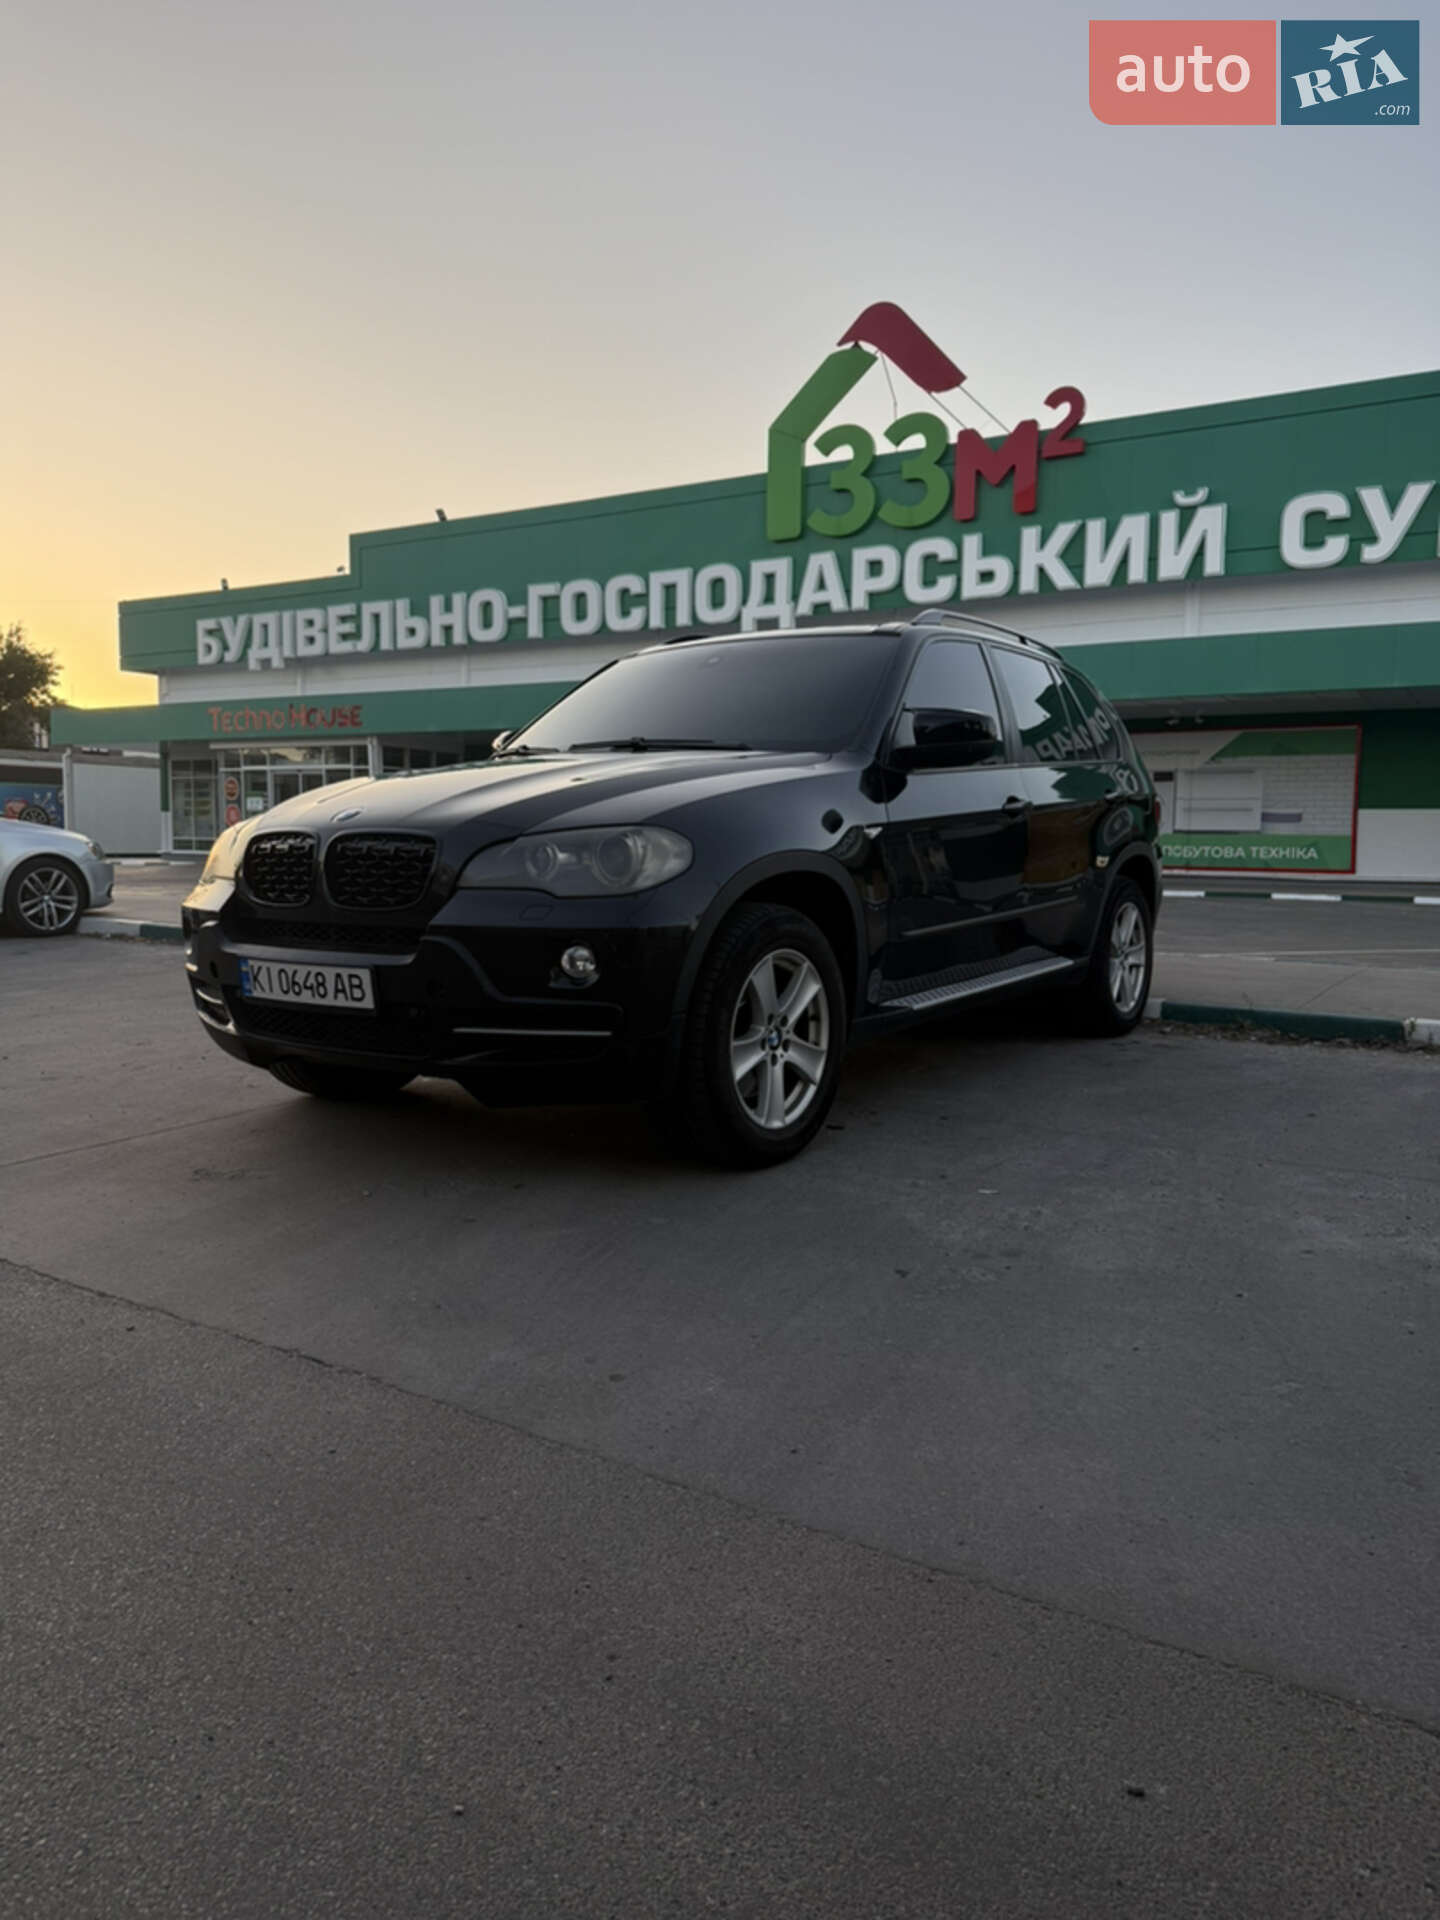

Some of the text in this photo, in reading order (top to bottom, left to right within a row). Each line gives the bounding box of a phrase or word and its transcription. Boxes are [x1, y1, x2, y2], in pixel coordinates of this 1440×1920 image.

[1279, 479, 1440, 570] СУ
[1249, 846, 1319, 860] ТЕХНІКА
[278, 968, 328, 999] 0648
